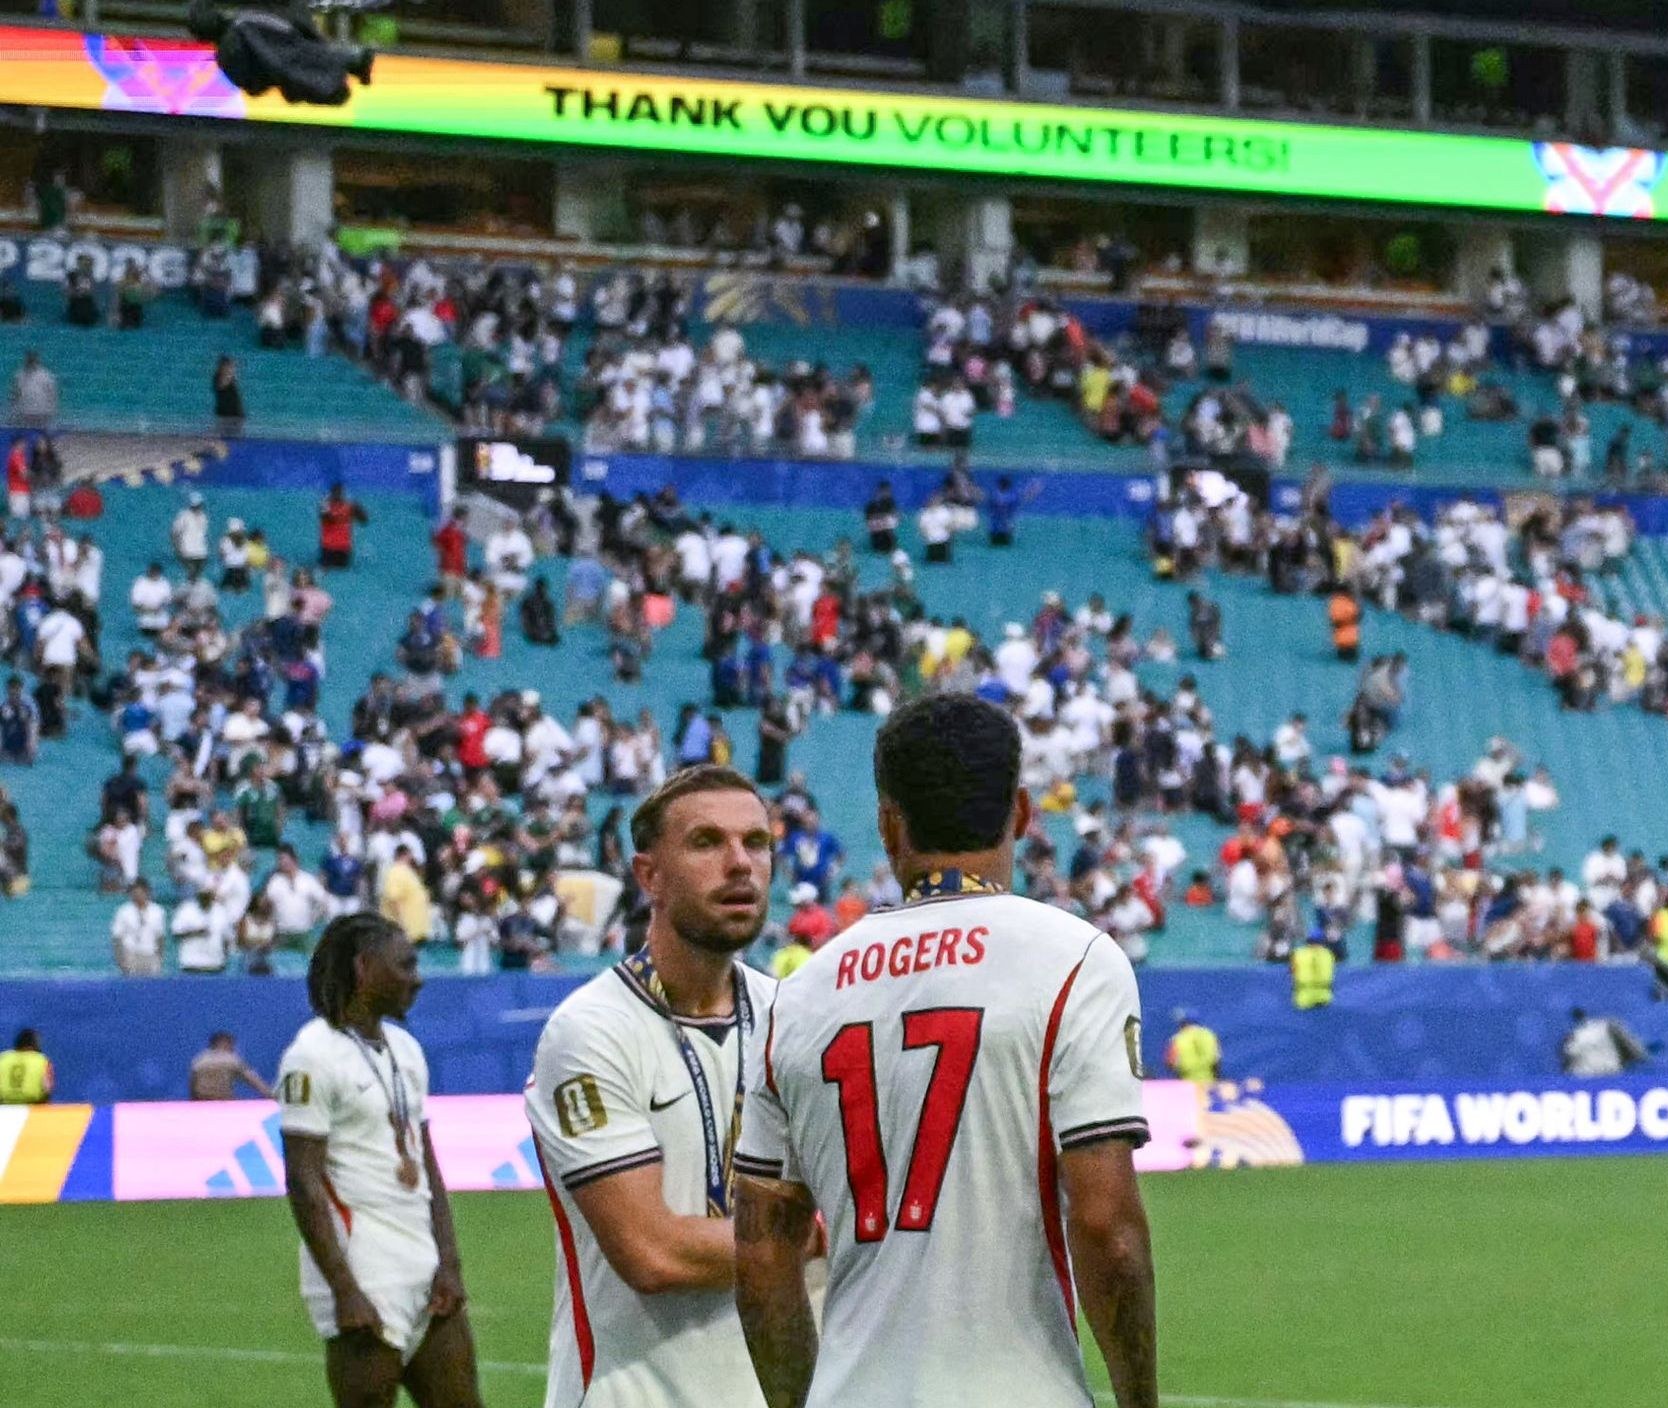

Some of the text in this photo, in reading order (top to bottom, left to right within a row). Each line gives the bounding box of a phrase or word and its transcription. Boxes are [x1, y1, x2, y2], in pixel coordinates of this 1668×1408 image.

[545, 86, 741, 129] THANK
[836, 926, 989, 990] ROGERS
[821, 1006, 985, 1242] 17
[1342, 1094, 1455, 1147] FIFA
[1457, 1090, 1637, 1144] WORLD
